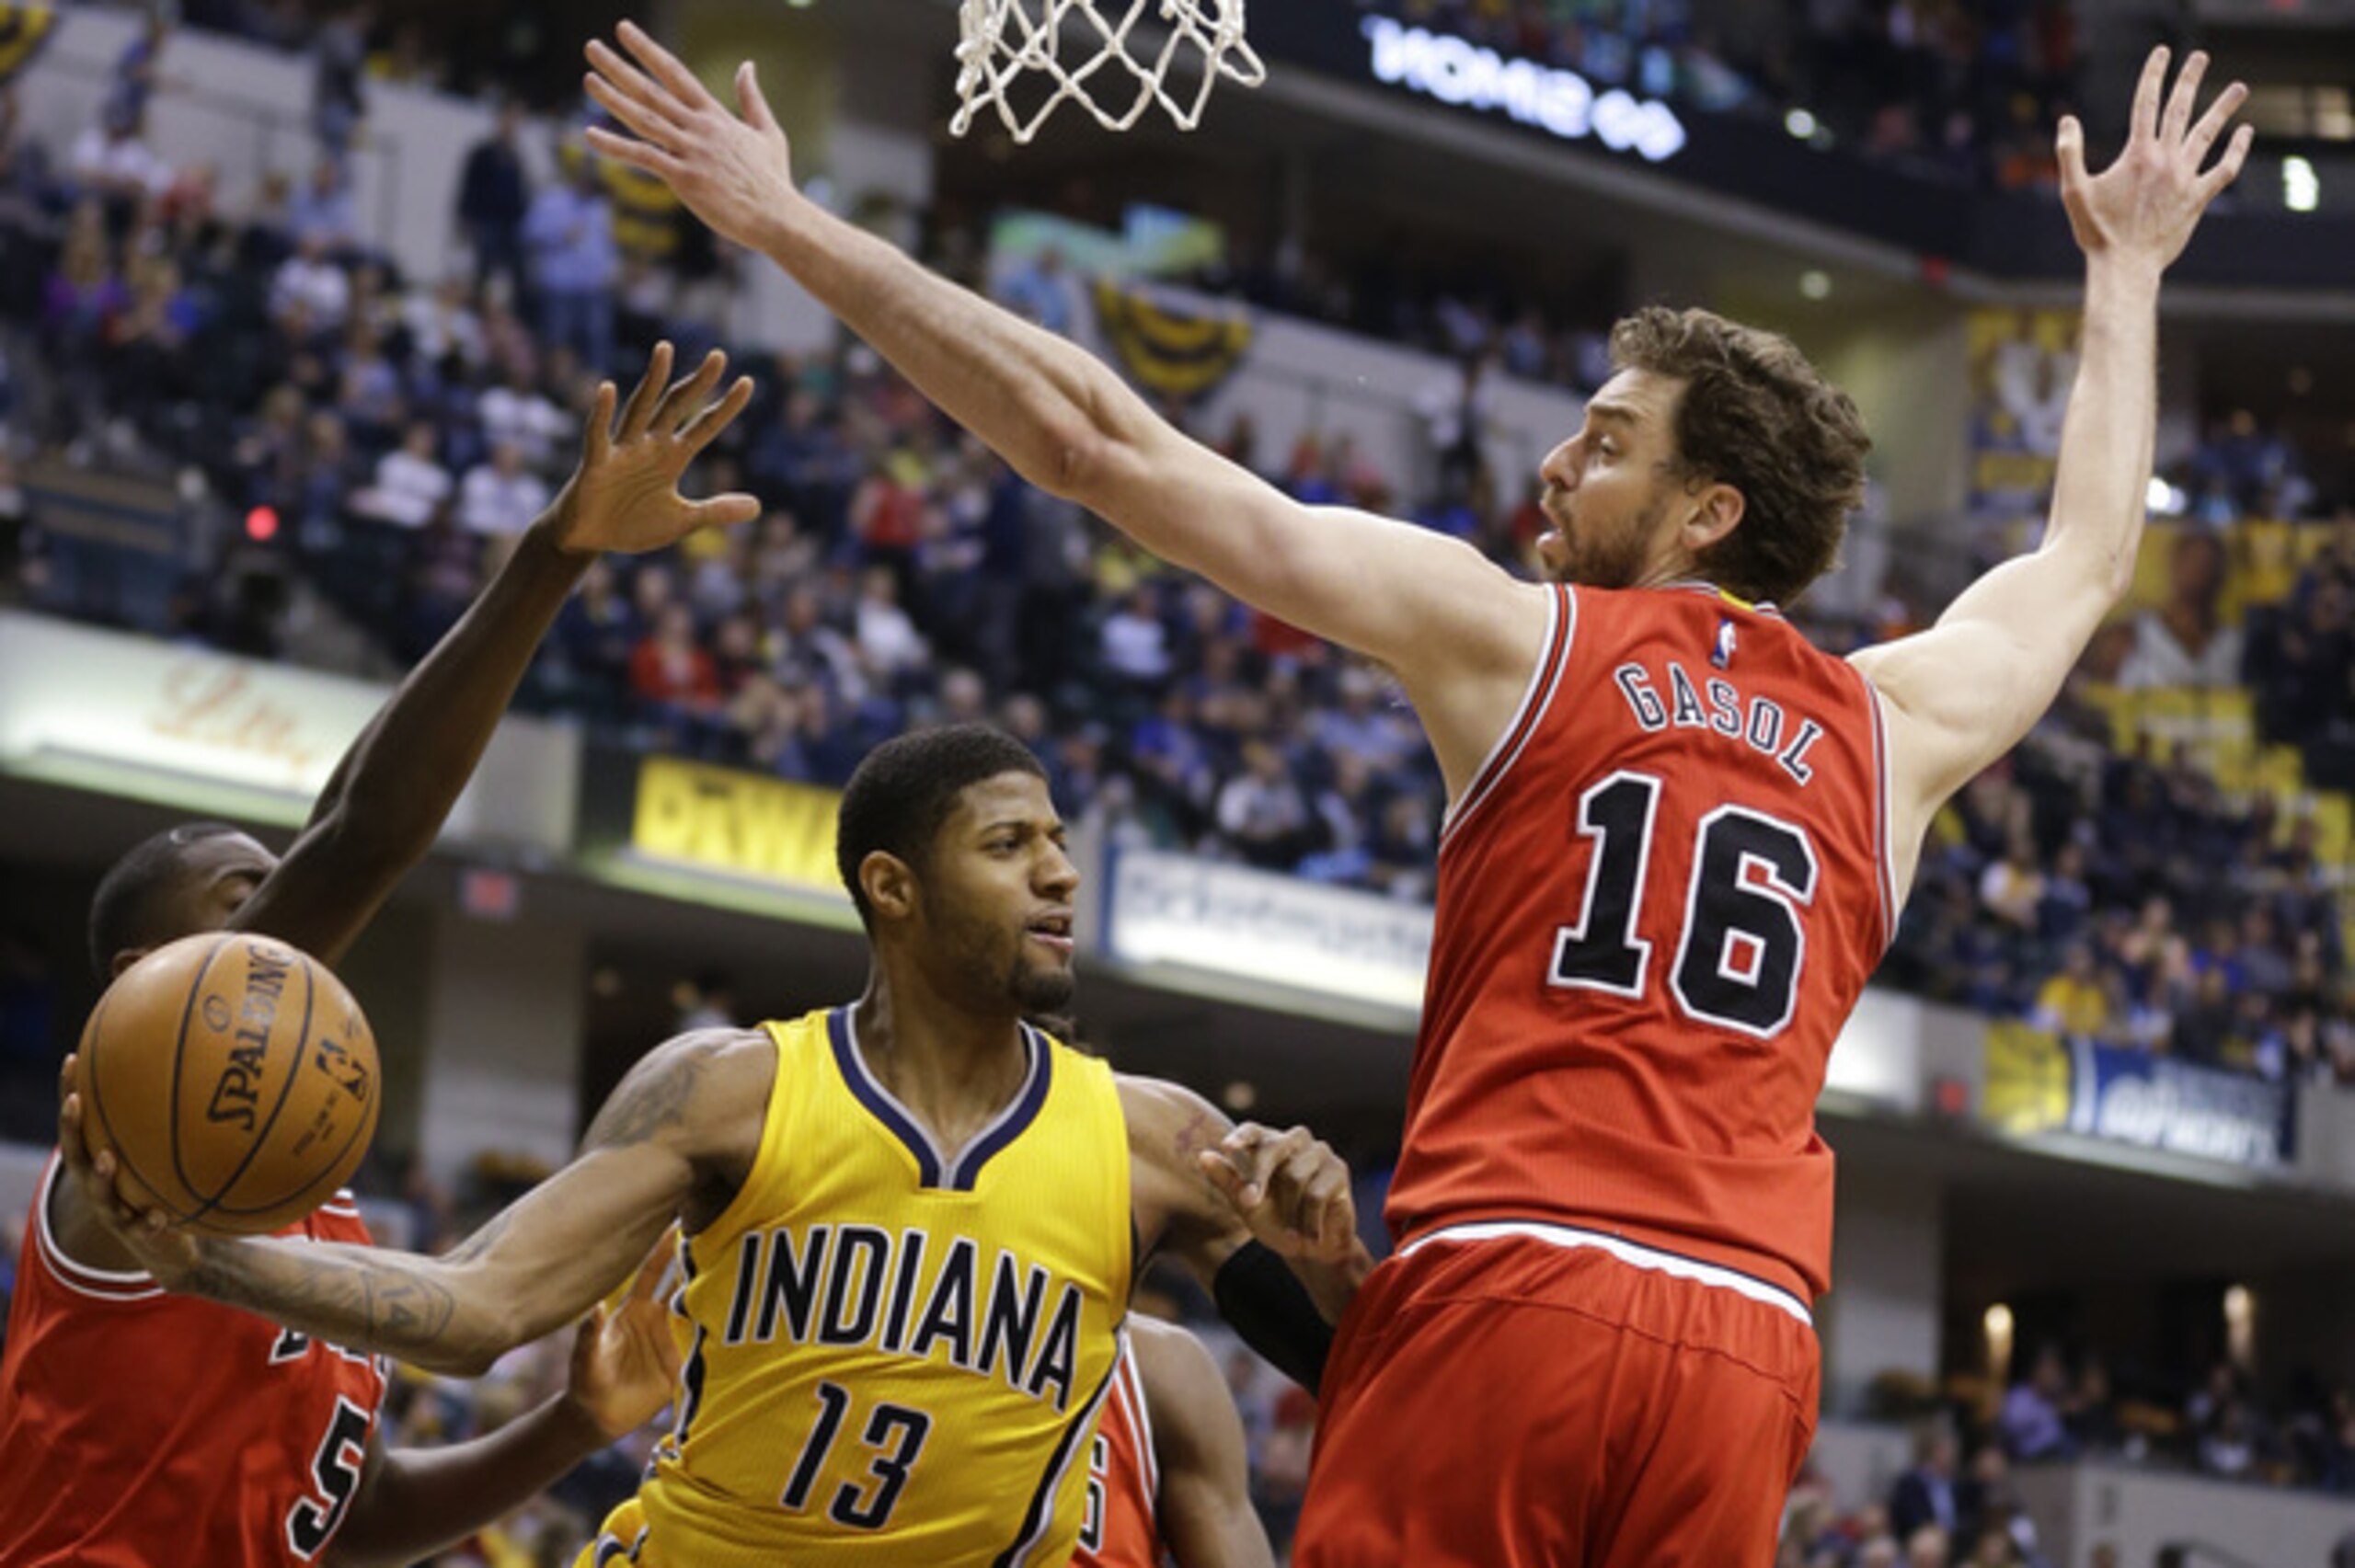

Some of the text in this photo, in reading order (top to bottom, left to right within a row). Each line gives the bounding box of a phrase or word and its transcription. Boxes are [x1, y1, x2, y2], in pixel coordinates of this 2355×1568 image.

[1614, 662, 1822, 786] GASOL
[1547, 771, 1818, 1040] 16
[208, 944, 295, 1132] SPALDING
[724, 1223, 1083, 1413] INDIANA
[285, 1393, 370, 1561] 5
[781, 1379, 931, 1530] 13
